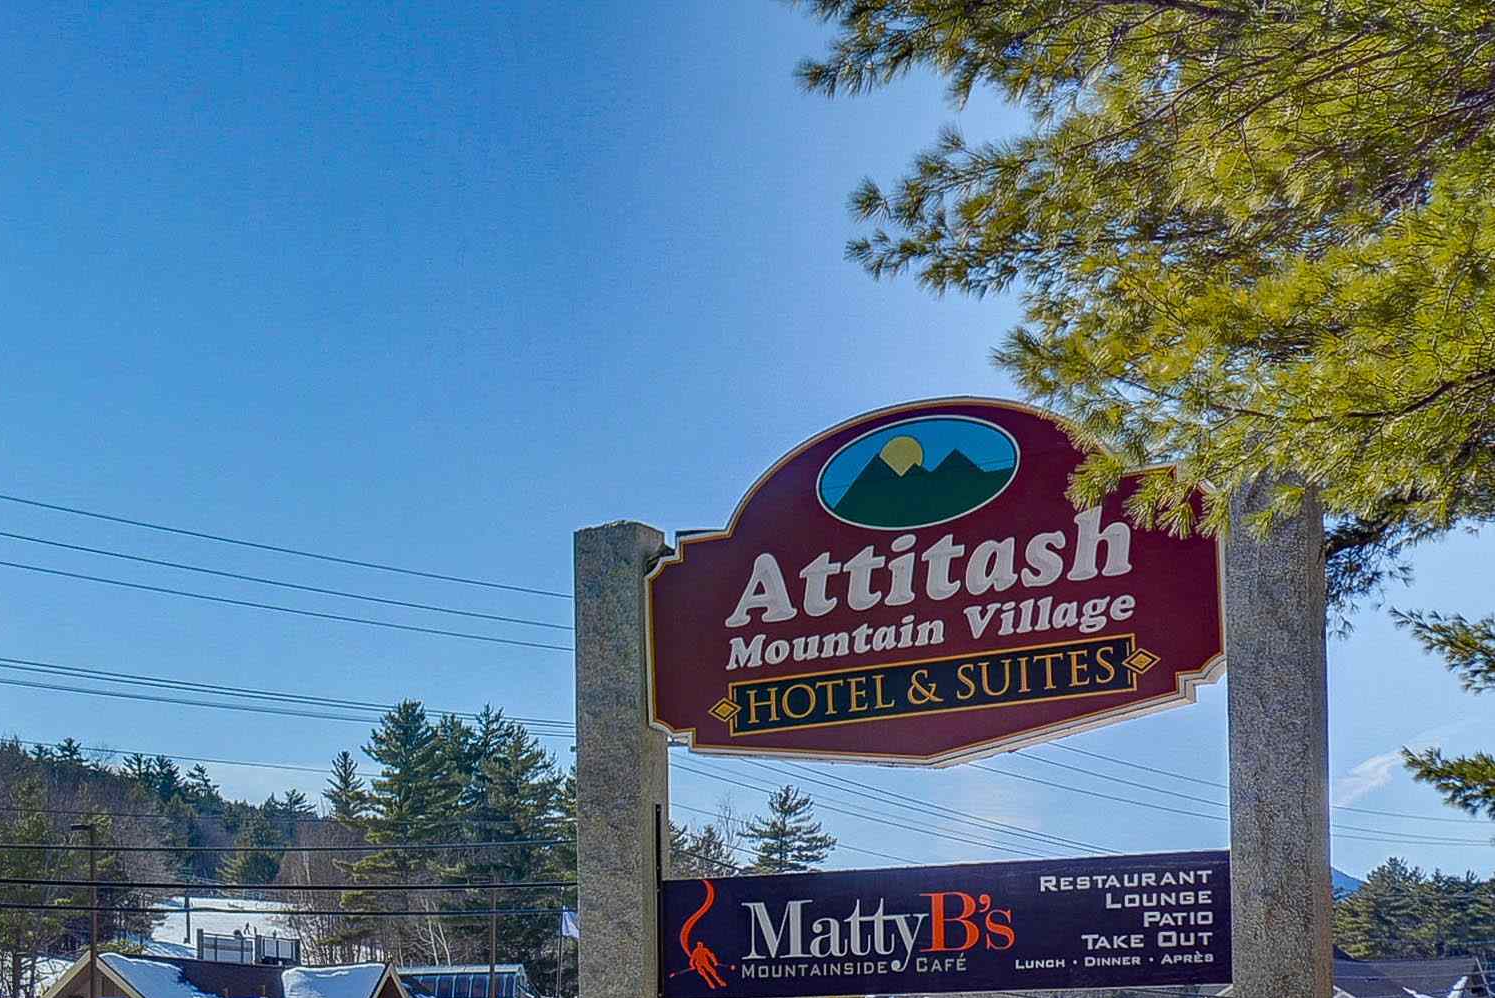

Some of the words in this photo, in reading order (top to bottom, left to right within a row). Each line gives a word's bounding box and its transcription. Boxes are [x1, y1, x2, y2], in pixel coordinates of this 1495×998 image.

[725, 507, 1133, 628] Attitash
[725, 614, 945, 671] Mountain
[964, 594, 1136, 640] Village
[746, 674, 896, 725] HOTEL
[908, 669, 944, 704] &
[956, 646, 1115, 701] SUITES
[1039, 870, 1213, 893] RESTAURANT
[1105, 890, 1213, 909] LOUNGE
[1143, 911, 1213, 928] PATIO
[1081, 933, 1144, 950] TAKE
[1157, 931, 1213, 948] OUT
[741, 960, 888, 979] MOUNTAINSIDE
[916, 952, 967, 973] CAFÉ
[1015, 958, 1066, 970] LUNCH
[1084, 956, 1141, 968] DINNER
